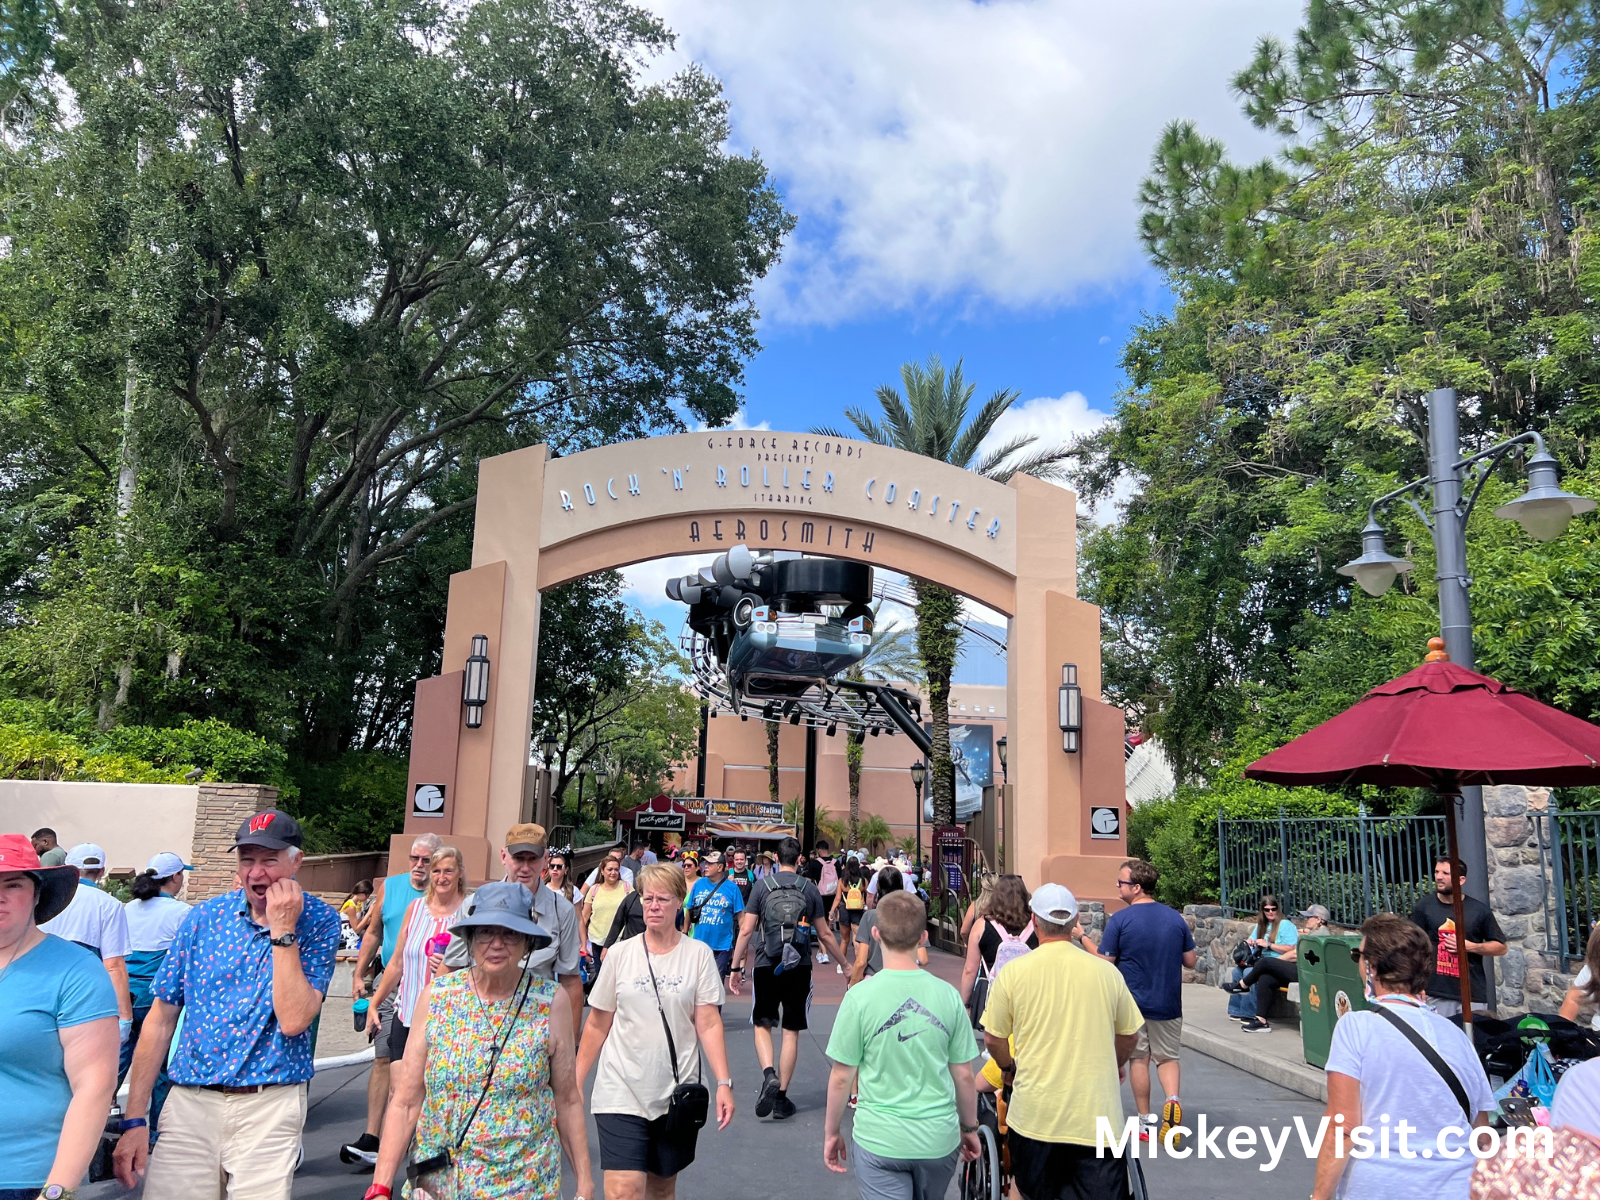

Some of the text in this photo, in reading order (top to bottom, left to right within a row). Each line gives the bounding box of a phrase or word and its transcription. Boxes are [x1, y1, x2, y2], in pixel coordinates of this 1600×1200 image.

[792, 440, 862, 459] RECORDS
[757, 453, 814, 465] PRESENTS
[559, 473, 641, 511] ROCK
[715, 464, 835, 493] ROLLER
[866, 478, 1001, 539] COASTER
[754, 493, 813, 505] STARRING
[688, 519, 875, 553] AEROSMITH
[736, 803, 761, 815] ROCK
[760, 806, 782, 815] Station
[249, 813, 276, 835] W
[666, 818, 682, 827] FACE
